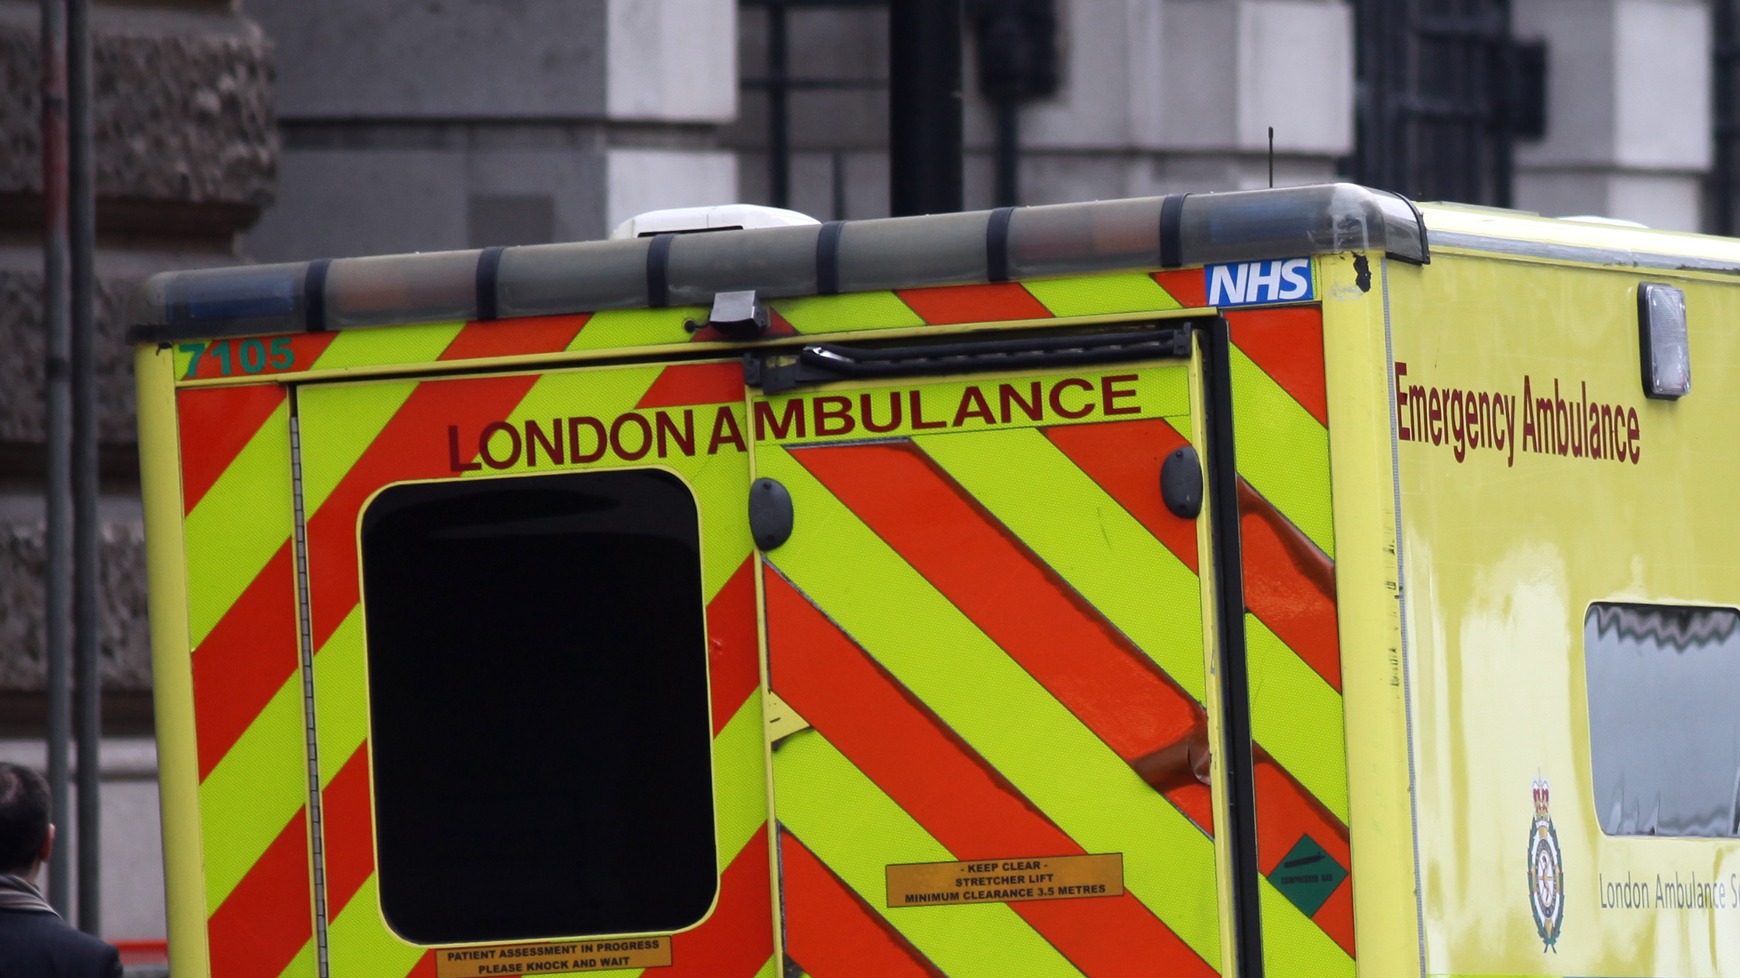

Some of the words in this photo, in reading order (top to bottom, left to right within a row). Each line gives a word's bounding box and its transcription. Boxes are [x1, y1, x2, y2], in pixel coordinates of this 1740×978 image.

[1208, 258, 1309, 306] NHS
[178, 337, 296, 378] 7105
[447, 409, 695, 473] LONDON
[708, 374, 1142, 455] AMBULANCE
[1395, 361, 1516, 468] Emergency
[1522, 374, 1641, 465] Ambulance
[955, 875, 1025, 888] STRETCHER
[1029, 874, 1054, 884] LIFT
[968, 862, 999, 873] KEEP
[1002, 861, 1041, 872] CLEAR
[905, 892, 960, 904] MINIMUM
[963, 889, 1034, 901] CLEARANCE
[1038, 887, 1055, 897] 3.5
[1058, 884, 1106, 896] METRES
[1600, 872, 1650, 909] London
[1655, 872, 1726, 910] Ambulance
[447, 949, 496, 962] PATIENT
[499, 945, 577, 959] ASSESSMENT
[581, 943, 594, 954] IN
[596, 939, 660, 952] PROGRESS
[478, 962, 523, 975] PLEASE
[526, 960, 569, 972] KNOCK
[572, 958, 597, 968] AND
[600, 956, 631, 967] WAIT
